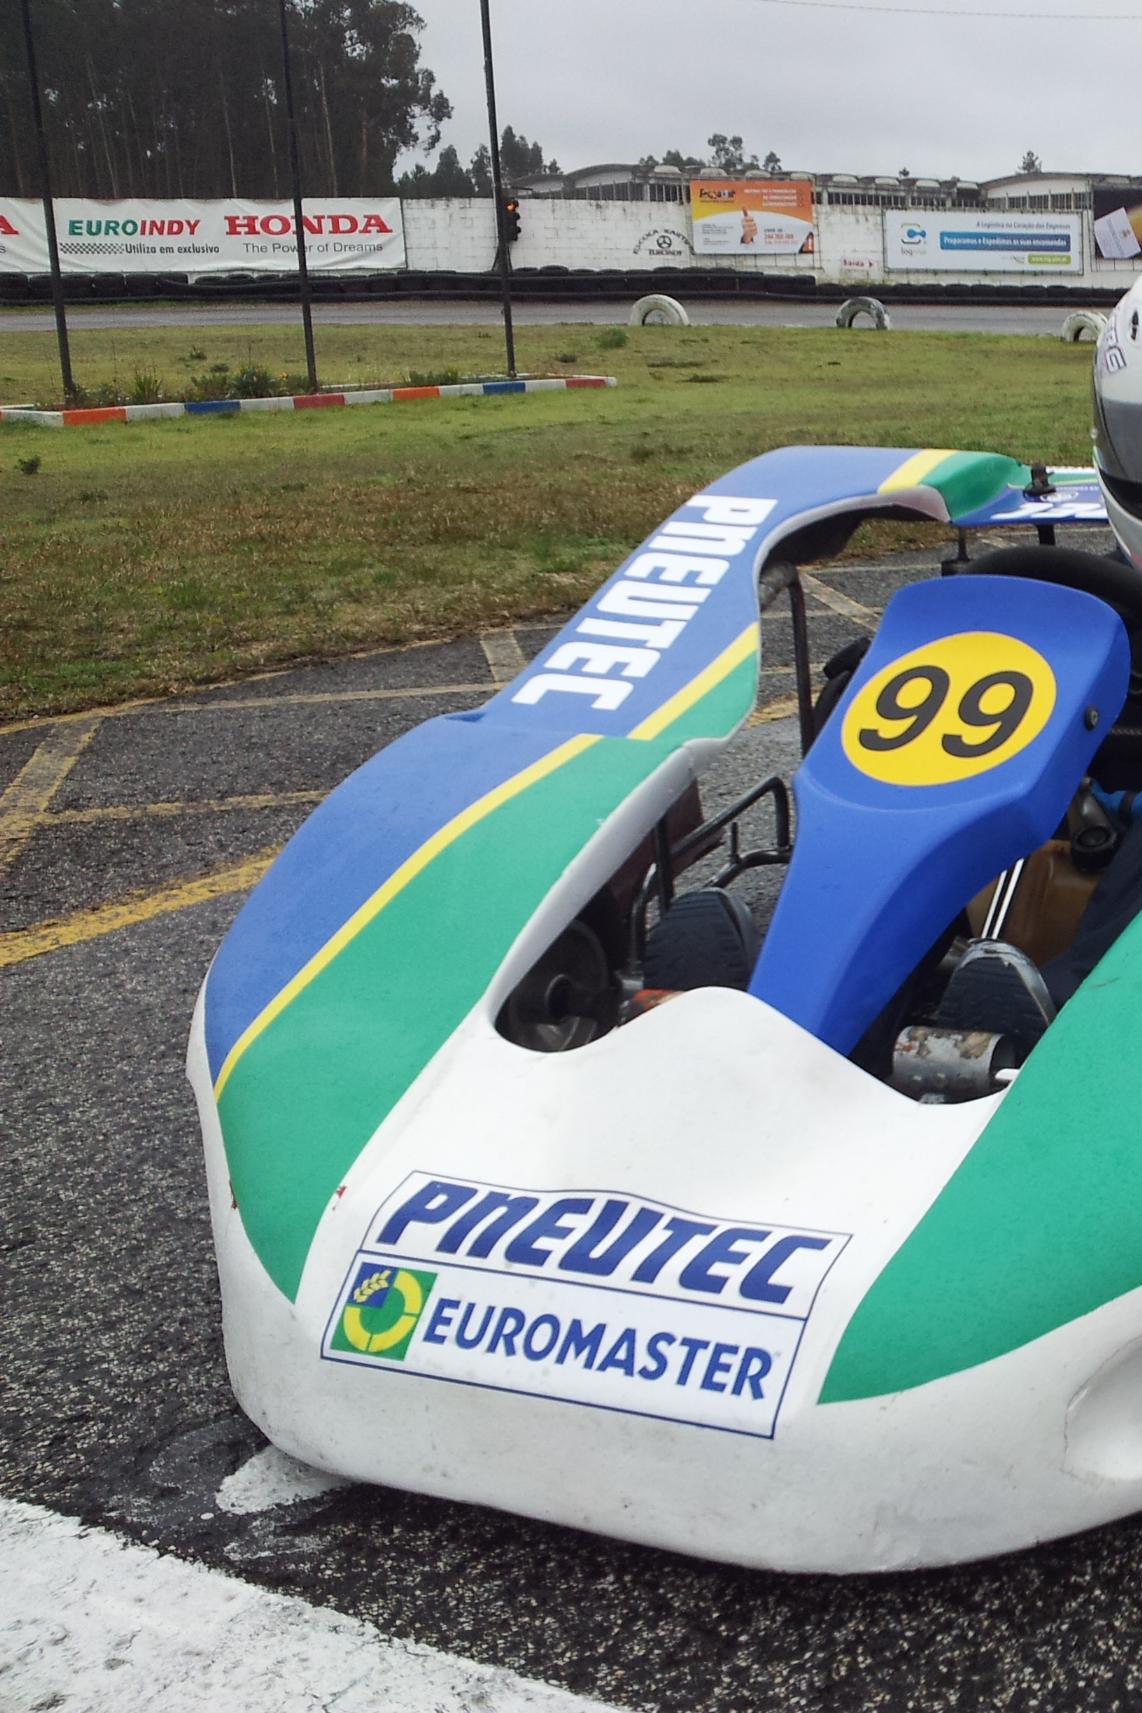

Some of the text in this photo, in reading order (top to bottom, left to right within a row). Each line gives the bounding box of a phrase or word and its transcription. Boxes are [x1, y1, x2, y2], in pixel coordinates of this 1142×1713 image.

[68, 219, 200, 236] EUROINDY
[224, 214, 393, 236] HONDA
[125, 243, 220, 255] Utiliza em exclusivo
[243, 243, 268, 254] The
[317, 242, 329, 253] of
[333, 242, 384, 253] Dreams
[859, 665, 1034, 758] 99
[422, 1298, 773, 1400] EUROMASTER
